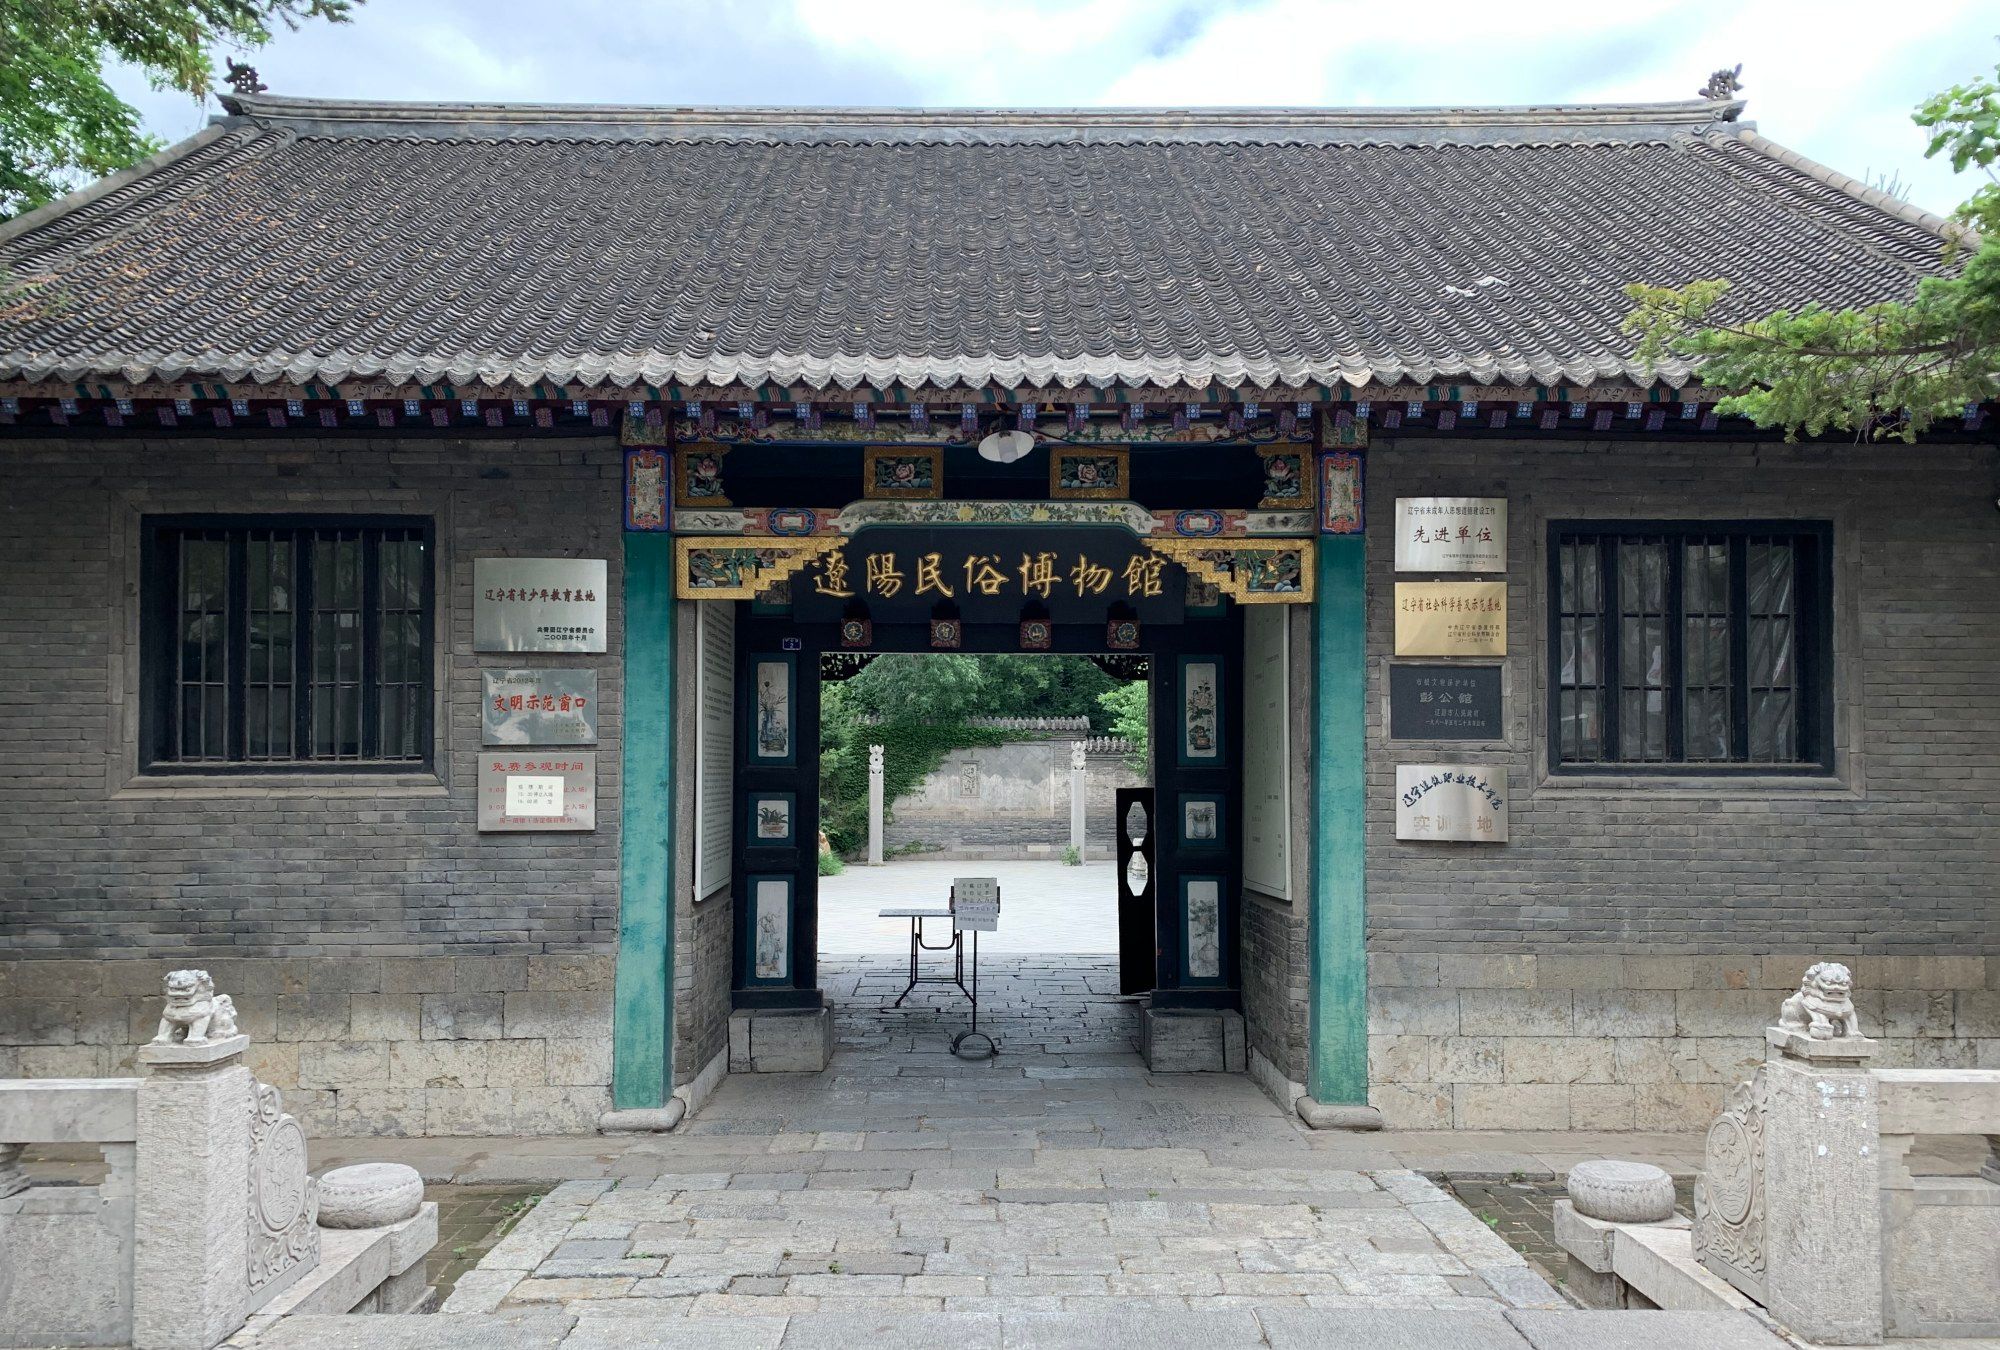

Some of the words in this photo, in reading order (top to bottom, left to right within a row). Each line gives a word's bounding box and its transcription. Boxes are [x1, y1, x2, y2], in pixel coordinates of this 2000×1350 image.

[1412, 525, 1493, 545] 先进单位
[813, 550, 1168, 598] 遼陽民俗博物館
[484, 588, 596, 602] 辽宁省青少年教育基地
[1402, 597, 1502, 612] 辽宁省社会科学普及示范基地
[536, 626, 595, 634] 共青团辽宁省委员会
[493, 692, 587, 712] 文明示范窗口
[492, 761, 584, 772] 免费参观时间
[1402, 772, 1504, 810] 辽宁建筑职业技术学院
